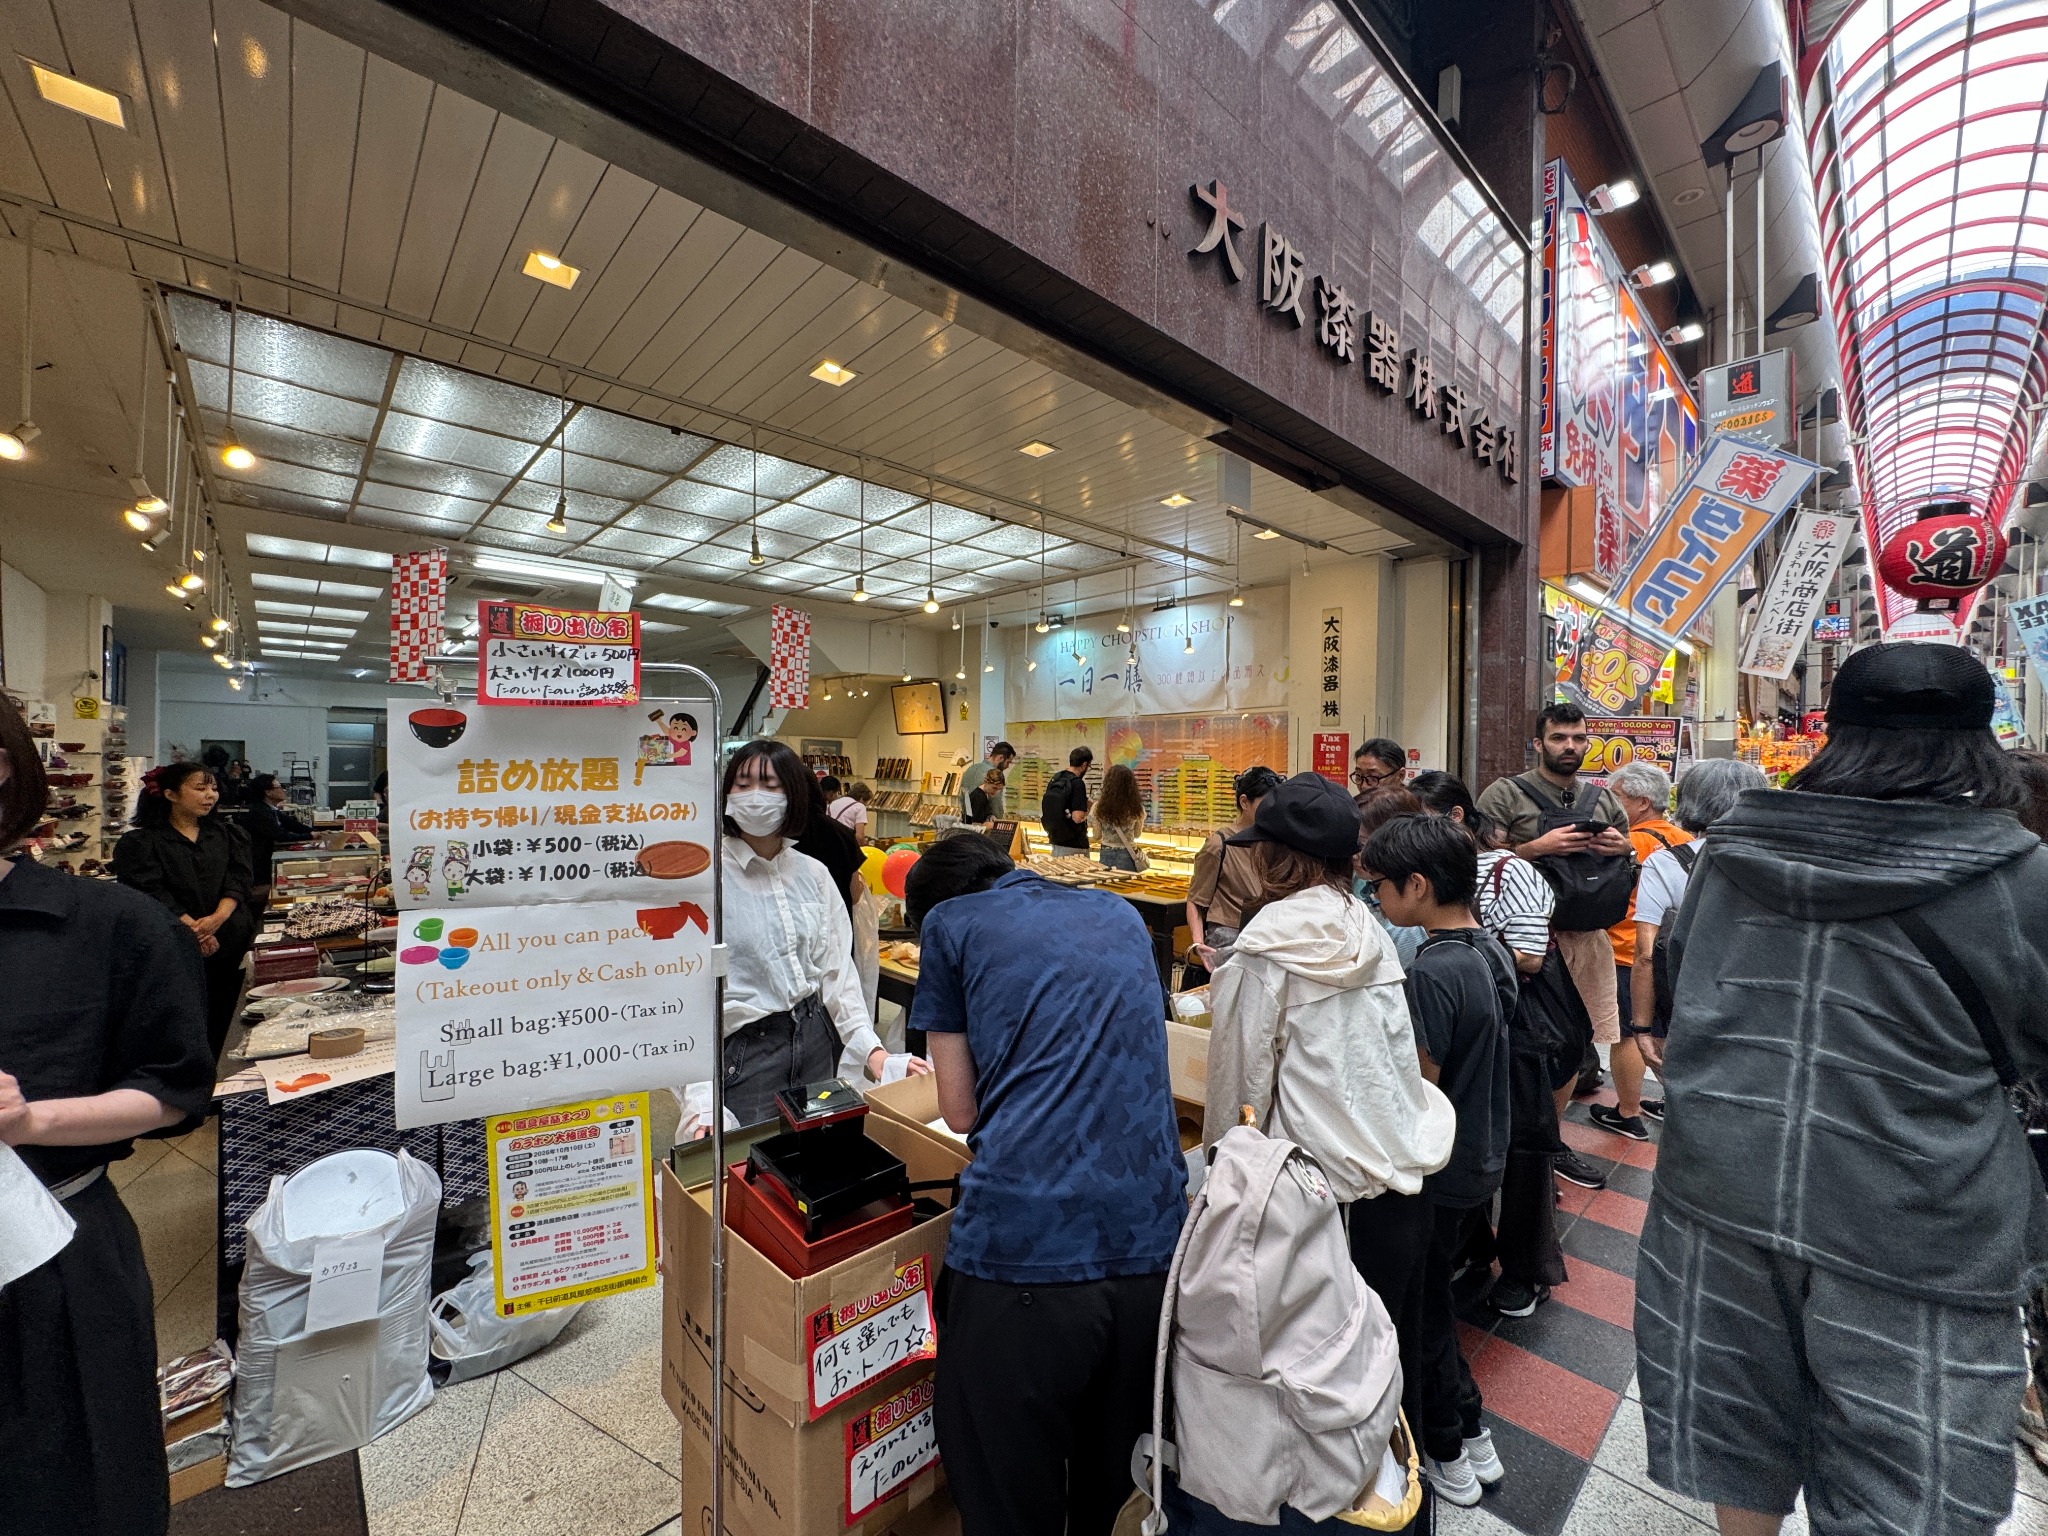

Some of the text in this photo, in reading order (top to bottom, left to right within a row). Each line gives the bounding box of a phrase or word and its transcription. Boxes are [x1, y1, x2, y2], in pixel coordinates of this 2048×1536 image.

[1188, 179, 1520, 484] 大阪漆器株式会社
[1909, 527, 1983, 587] 道
[1763, 540, 1810, 633] にぎわいキャンペーン
[1774, 540, 1837, 637] 大阪商店街
[520, 610, 628, 638] 掘り出し市
[1101, 624, 1184, 648] CHOPSTICK
[1190, 616, 1235, 634] SHOP
[492, 642, 640, 661] 小さいサイズは500円
[1060, 638, 1097, 653] HAPPY
[488, 664, 614, 681] 大きいサイズ1000円
[1059, 657, 1143, 696] 一日一膳
[1322, 734, 1340, 742] Tax
[457, 756, 648, 795] 詰め放題！
[409, 801, 698, 831] (お持ち帰り/現金支払のみ)
[478, 919, 654, 954] All you can pack
[416, 978, 520, 1004] (Takeout
[526, 970, 571, 993] only
[654, 952, 704, 978] only)
[440, 1018, 504, 1043] Small
[662, 997, 684, 1015] in)
[428, 1065, 494, 1089] Large
[673, 1036, 696, 1054] in)
[514, 1110, 590, 1130] 道具屋筋まつり
[510, 1126, 600, 1151] ガラポン大抽選会
[815, 1304, 914, 1376] 何を選んでも
